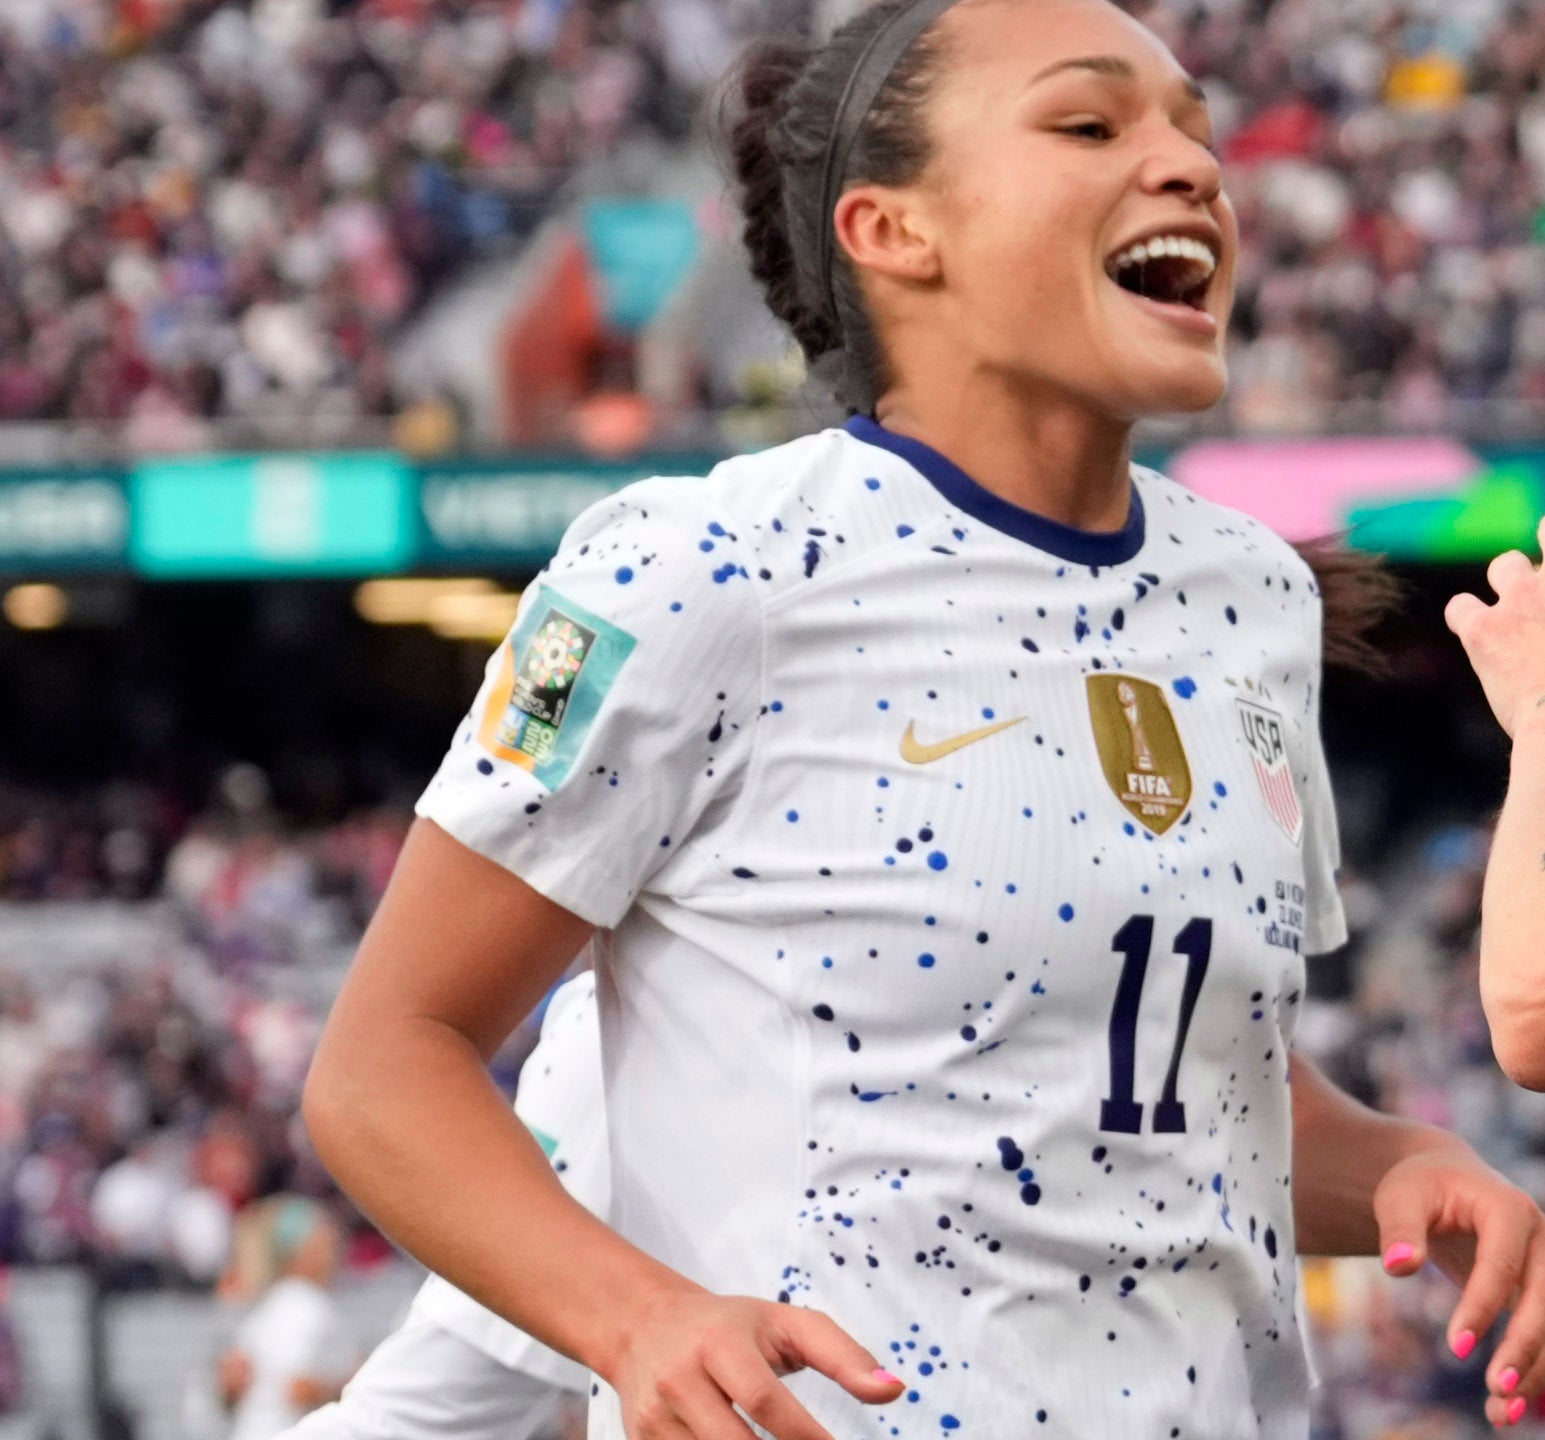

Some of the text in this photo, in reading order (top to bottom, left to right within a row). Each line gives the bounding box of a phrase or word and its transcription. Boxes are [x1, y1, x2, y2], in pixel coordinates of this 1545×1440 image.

[1239, 709, 1283, 766] USA
[1127, 773, 1171, 796] FIFA
[1098, 914, 1213, 1135] 11
